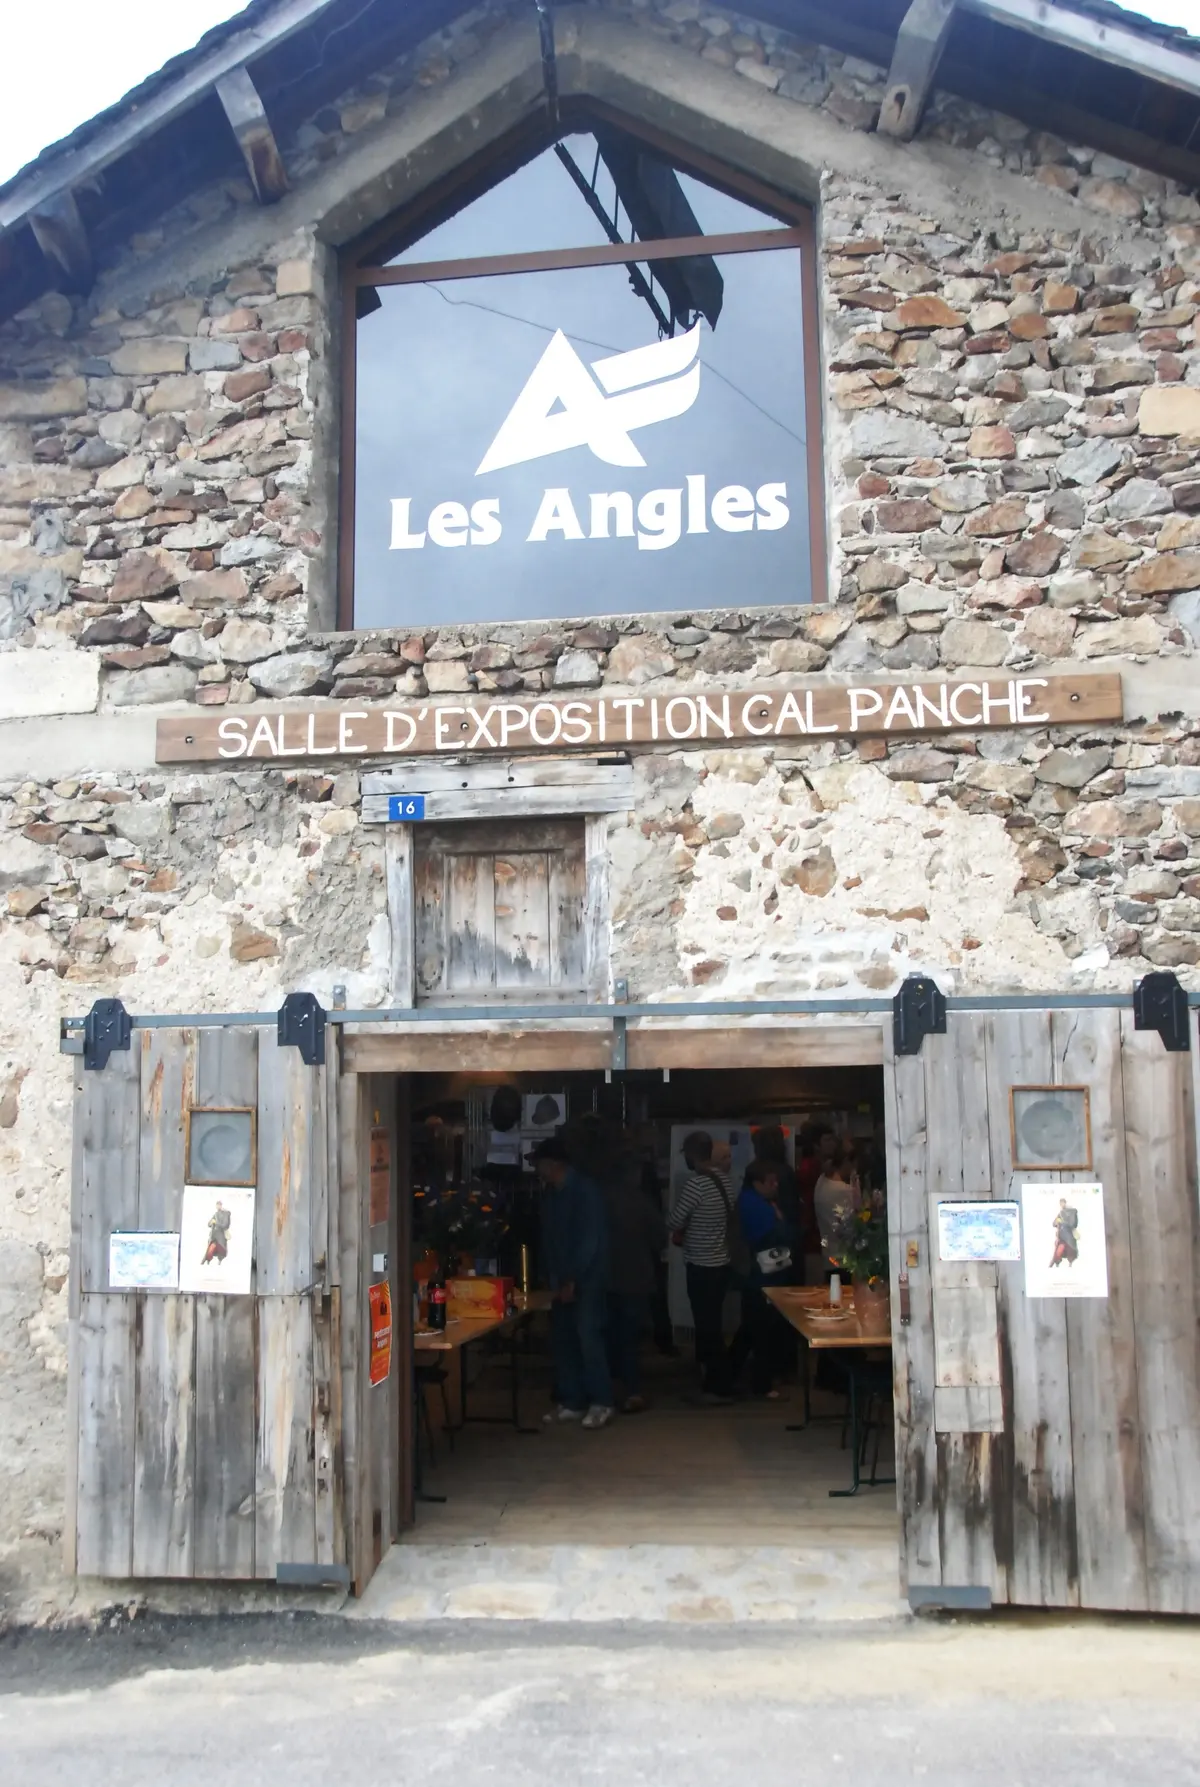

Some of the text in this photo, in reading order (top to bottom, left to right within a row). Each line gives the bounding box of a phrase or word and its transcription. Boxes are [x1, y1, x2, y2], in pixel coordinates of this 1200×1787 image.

[389, 474, 790, 551] Les Angles
[218, 677, 1051, 758] SALLE D'EXPOSITION CAL PANCHE
[397, 801, 415, 815] 16
